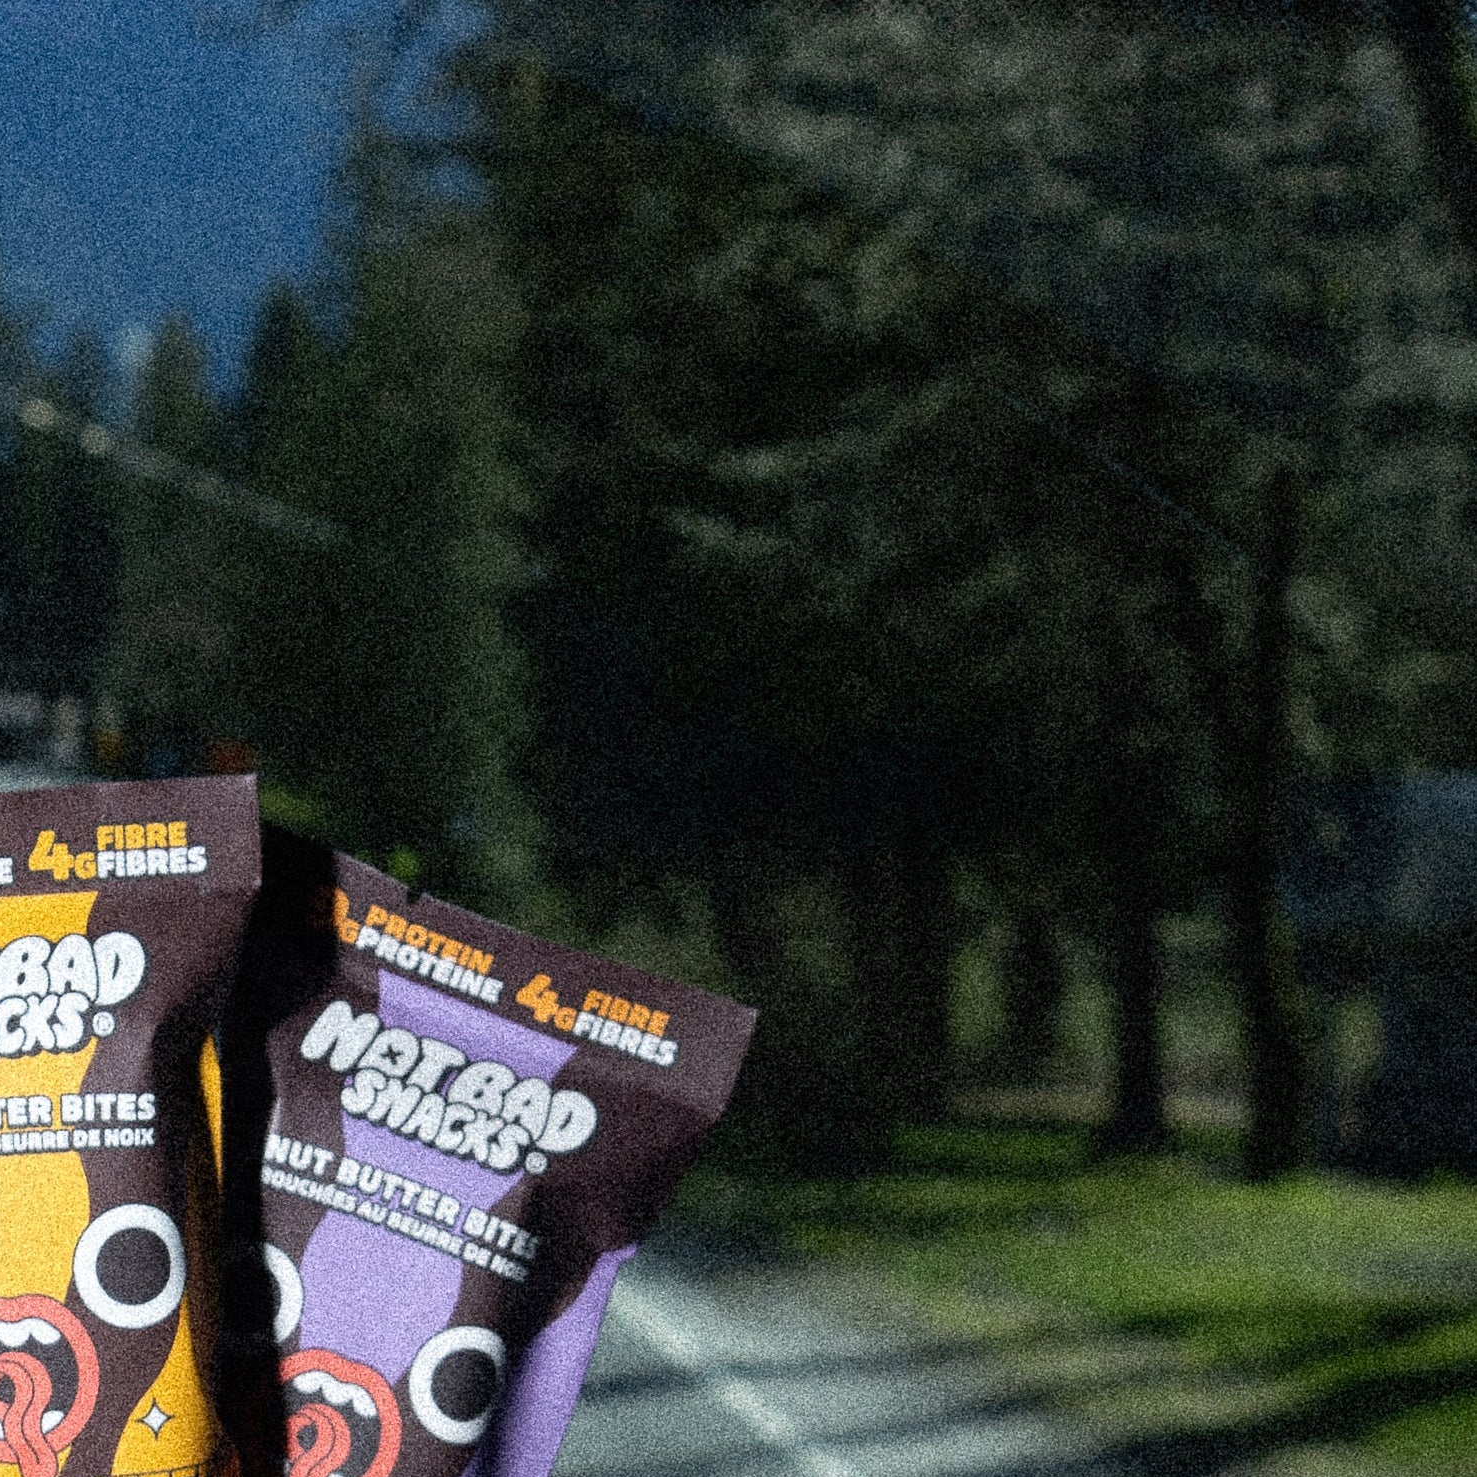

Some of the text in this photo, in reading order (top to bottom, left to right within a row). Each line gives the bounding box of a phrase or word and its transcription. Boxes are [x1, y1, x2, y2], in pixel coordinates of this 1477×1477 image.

[96, 822, 188, 852] FIBRE
[96, 847, 207, 878] FIBRES
[366, 904, 494, 974] PROTEIN
[583, 989, 670, 1036] FIBRE
[572, 1011, 678, 1066] FIBRES
[300, 1000, 597, 1153] NOT BAD
[61, 1093, 156, 1122] BITES
[341, 1067, 532, 1172] SNACKS
[73, 1130, 101, 1149] DE
[104, 1128, 156, 1148] NOIX
[264, 1134, 541, 1260] NUT BUTTER BITES
[357, 1200, 387, 1224] AU
[463, 1241, 492, 1268] DE
